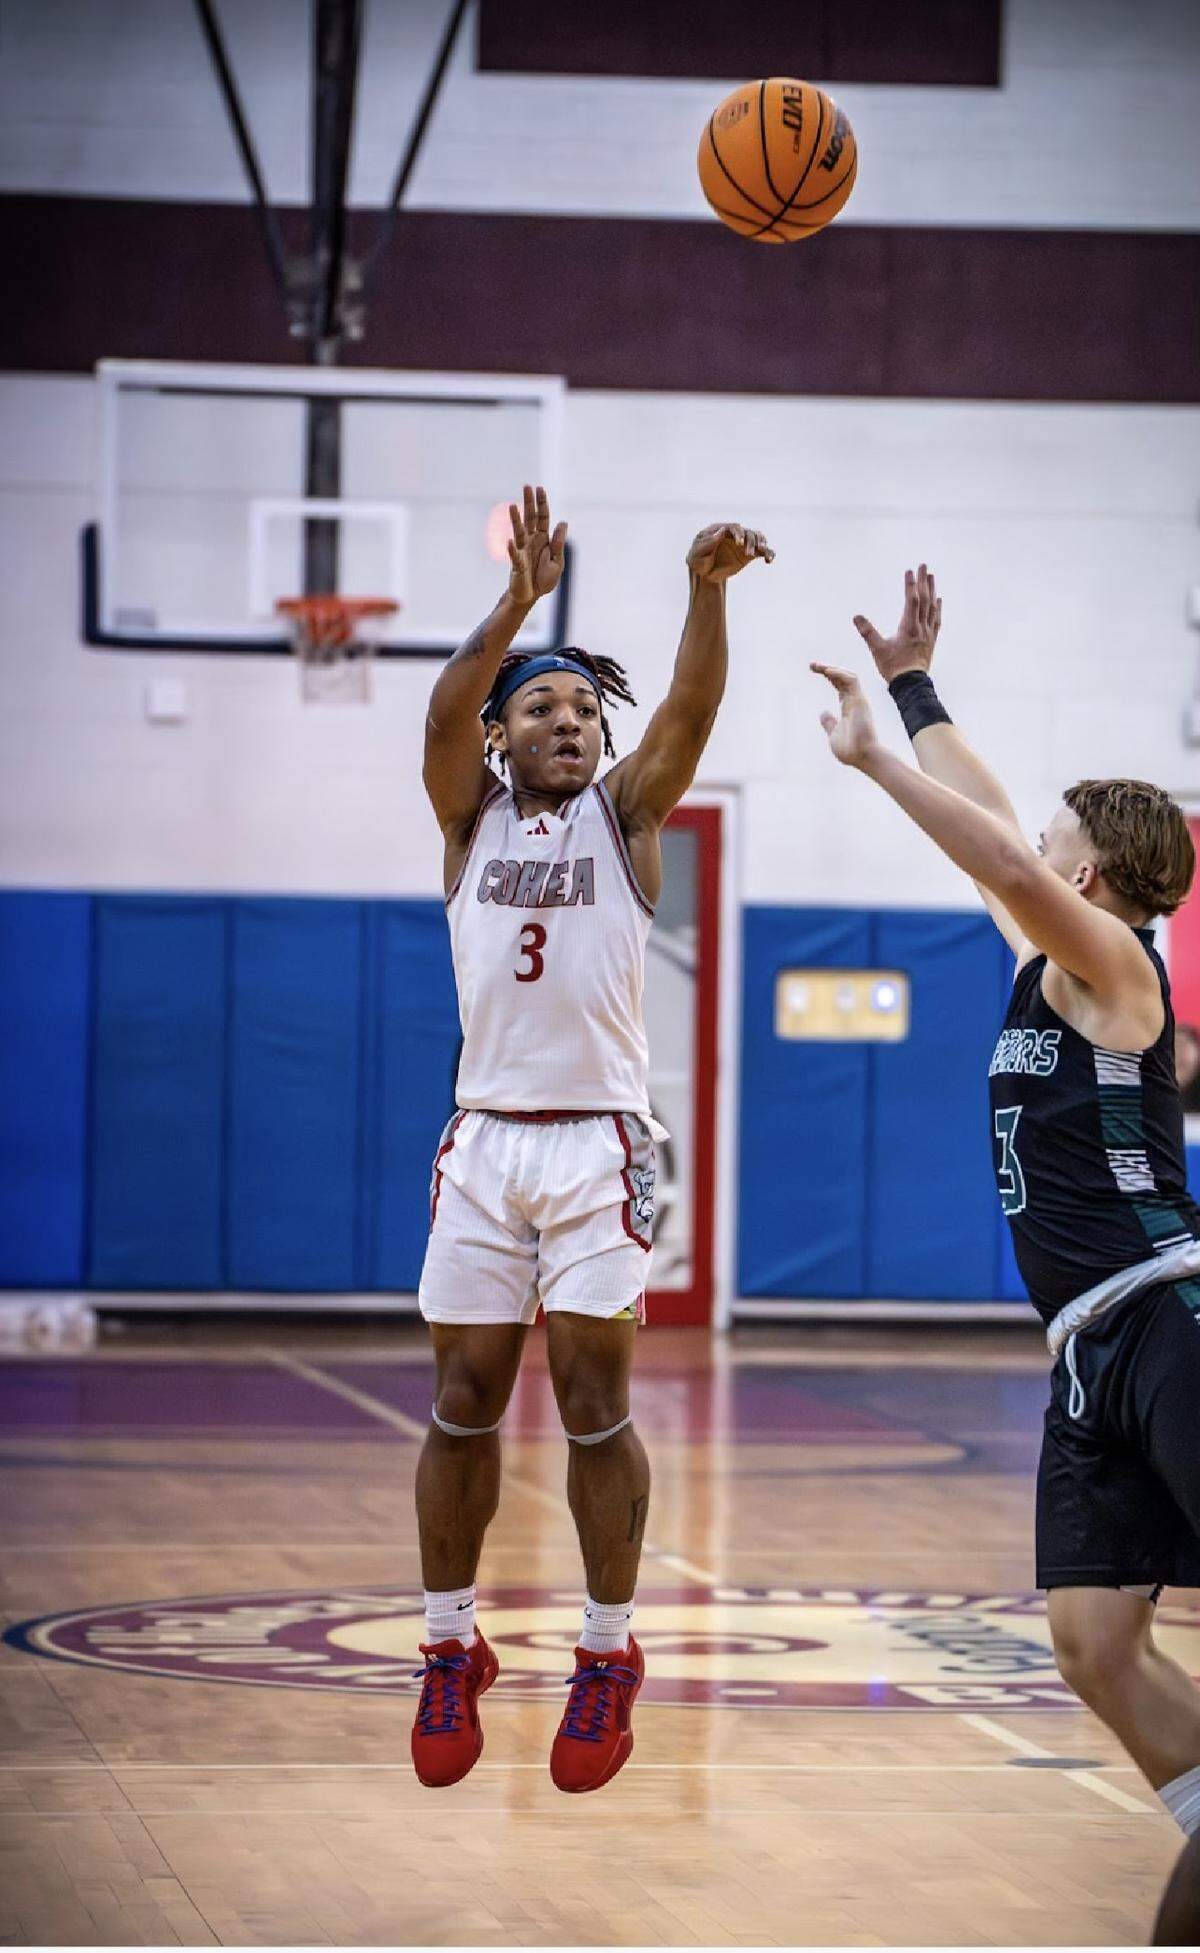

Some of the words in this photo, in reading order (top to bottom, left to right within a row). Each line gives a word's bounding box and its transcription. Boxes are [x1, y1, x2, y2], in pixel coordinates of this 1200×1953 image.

[782, 84, 802, 131] EVO
[477, 857, 595, 908] COHEA
[514, 922, 547, 982] 3
[994, 1104, 1027, 1216] 3
